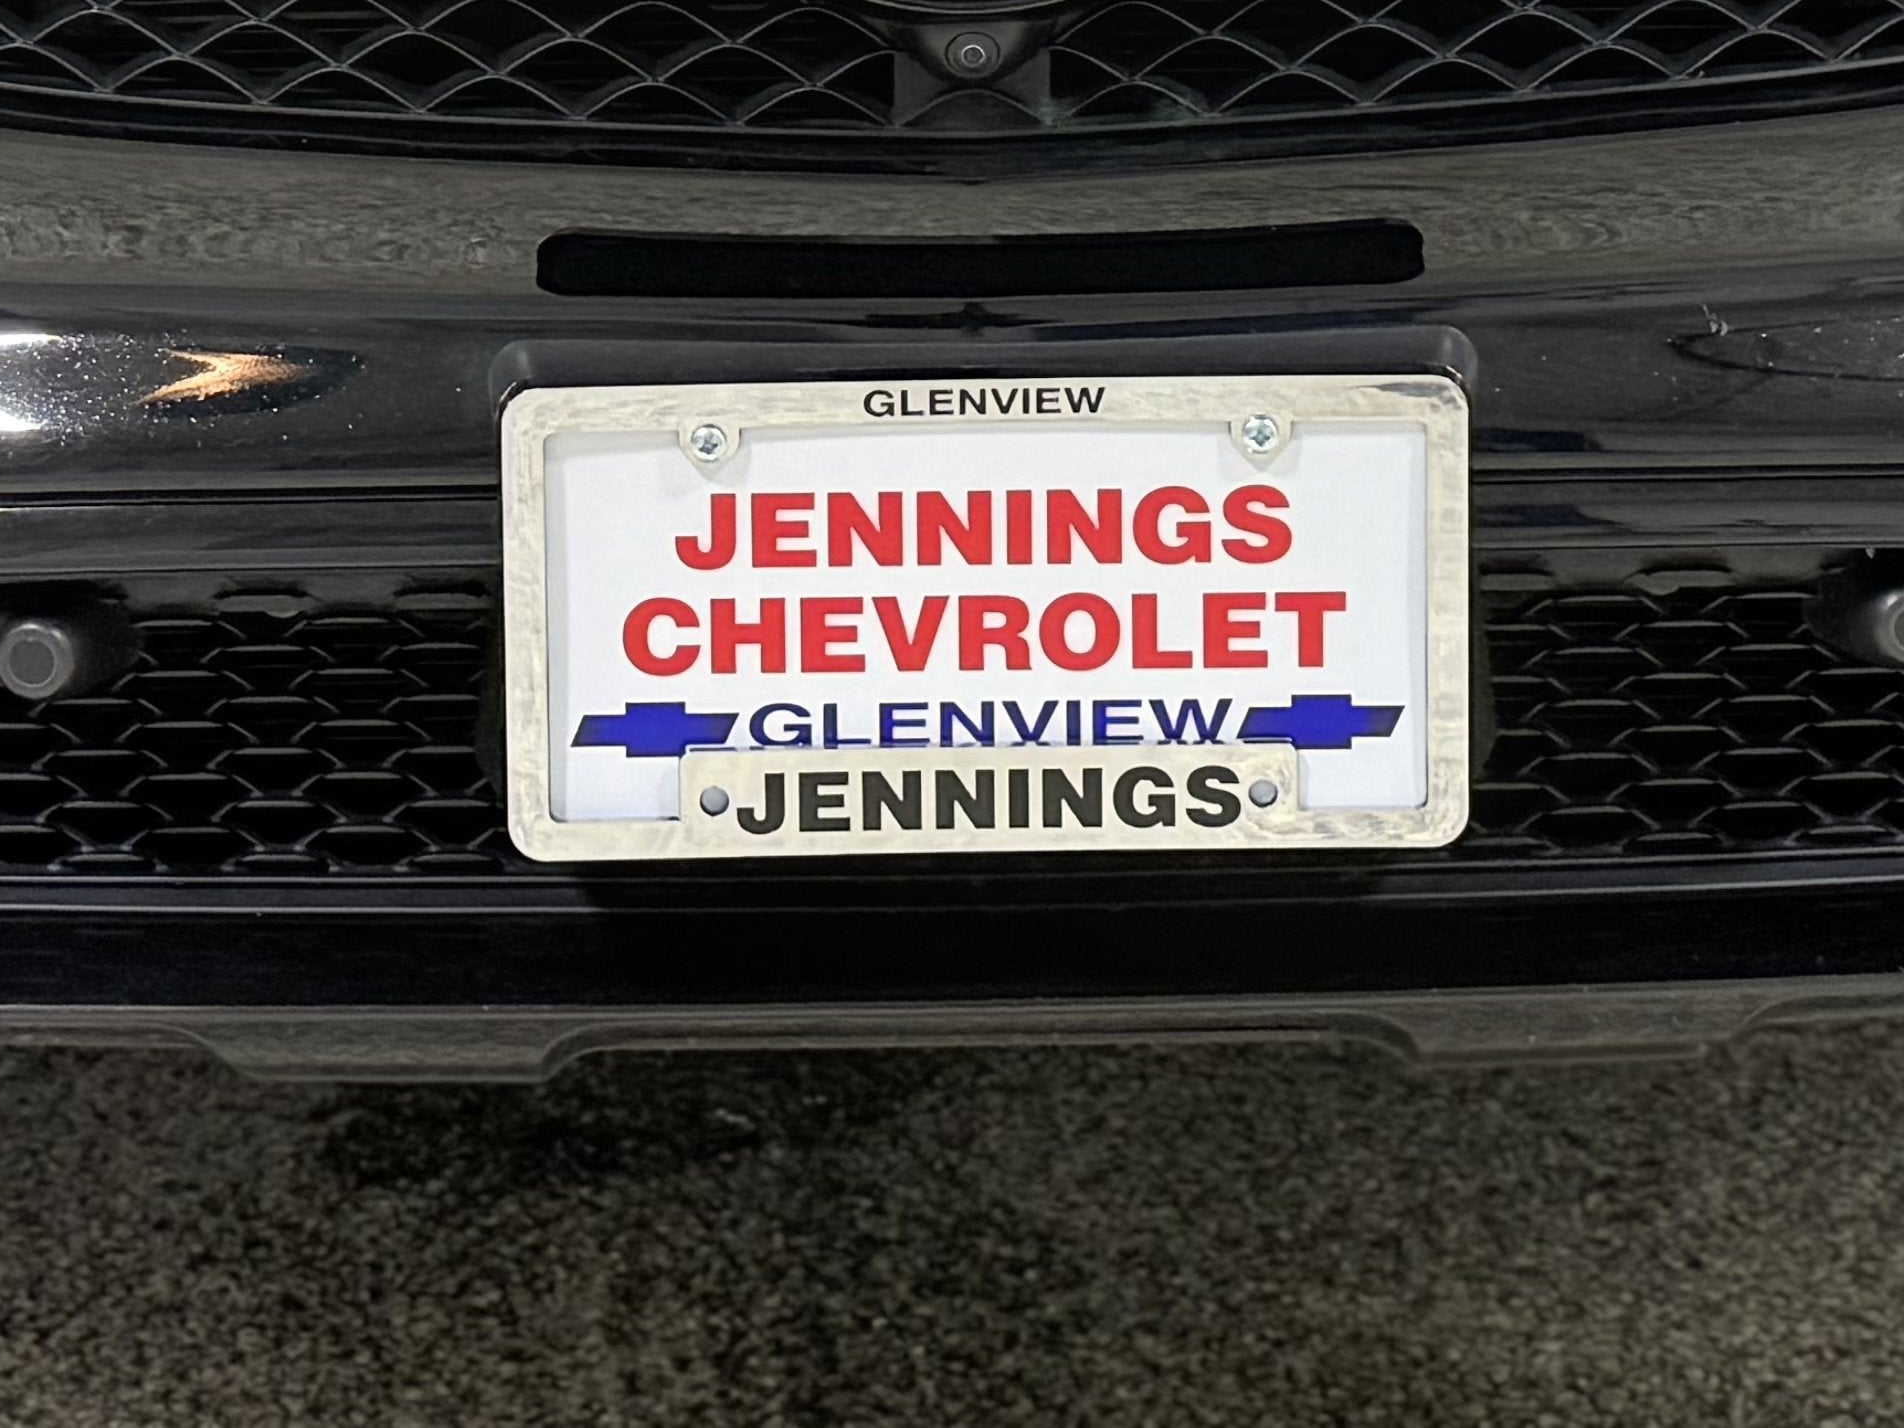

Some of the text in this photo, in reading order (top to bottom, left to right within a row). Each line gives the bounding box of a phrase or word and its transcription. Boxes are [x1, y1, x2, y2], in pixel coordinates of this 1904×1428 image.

[862, 387, 1106, 416] GLENVIEW
[675, 485, 1293, 571] JENNINGS
[623, 592, 1346, 677] CHEVROLET
[748, 699, 1233, 747] GLENVIEW
[736, 766, 1242, 835] JENNINGS
